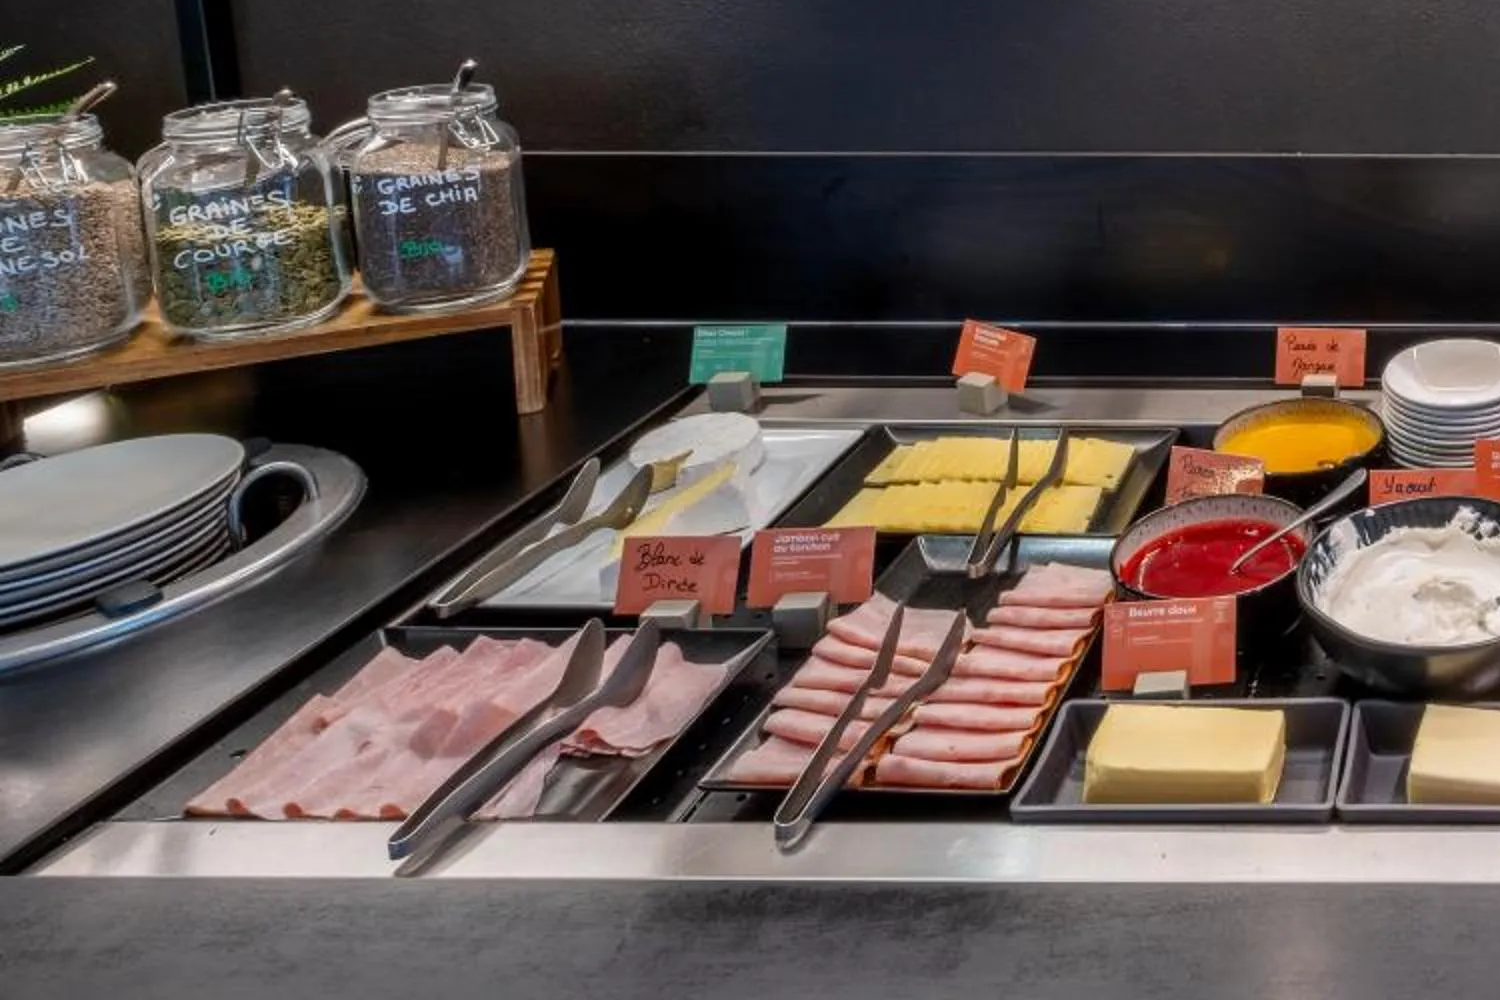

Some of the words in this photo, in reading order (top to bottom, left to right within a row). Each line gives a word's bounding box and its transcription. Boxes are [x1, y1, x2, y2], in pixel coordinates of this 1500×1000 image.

[376, 163, 482, 195] GRAINES
[379, 197, 418, 216] DE
[0, 208, 73, 233] NES
[211, 217, 252, 238] DE
[0, 235, 26, 254] E
[173, 227, 296, 270] COURGE
[1128, 606, 1165, 618] Beurre
[1167, 604, 1198, 616] doux
